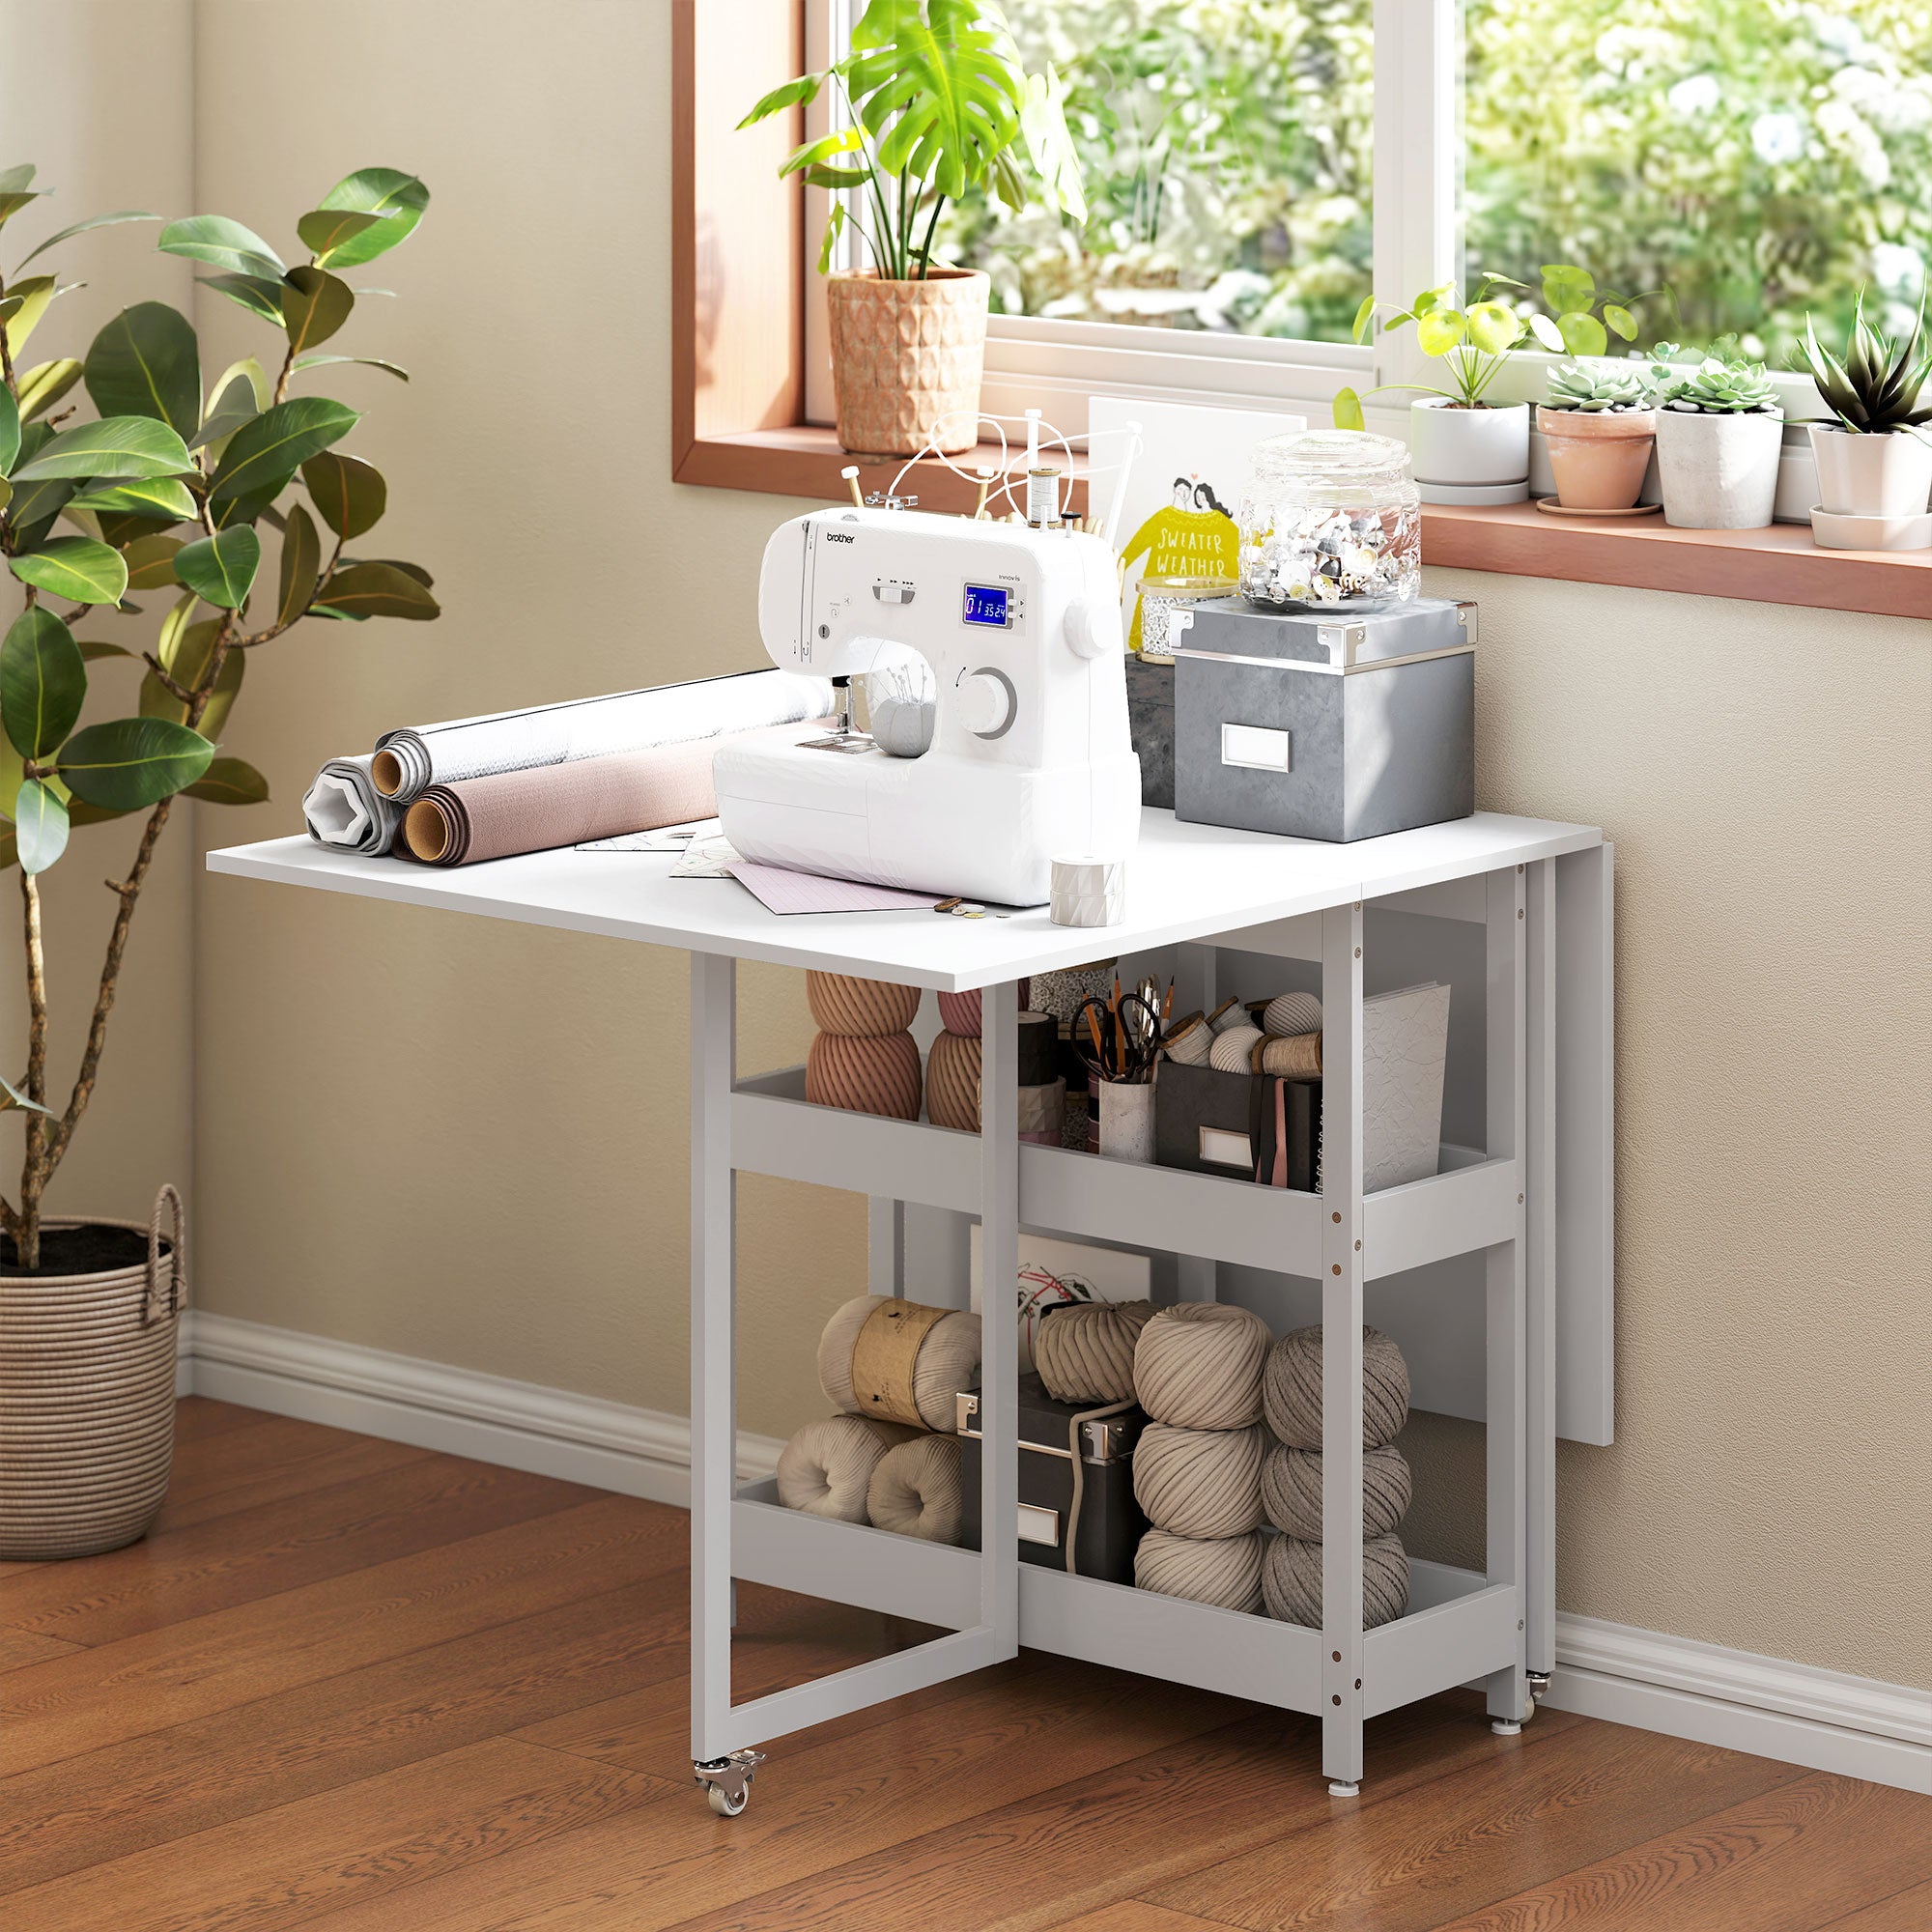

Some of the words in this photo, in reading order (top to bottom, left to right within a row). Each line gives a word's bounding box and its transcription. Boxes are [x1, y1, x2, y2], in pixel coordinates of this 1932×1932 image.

[827, 532, 855, 544] brother
[1157, 527, 1224, 554] SWEATER
[1157, 554, 1228, 579] WEATHER
